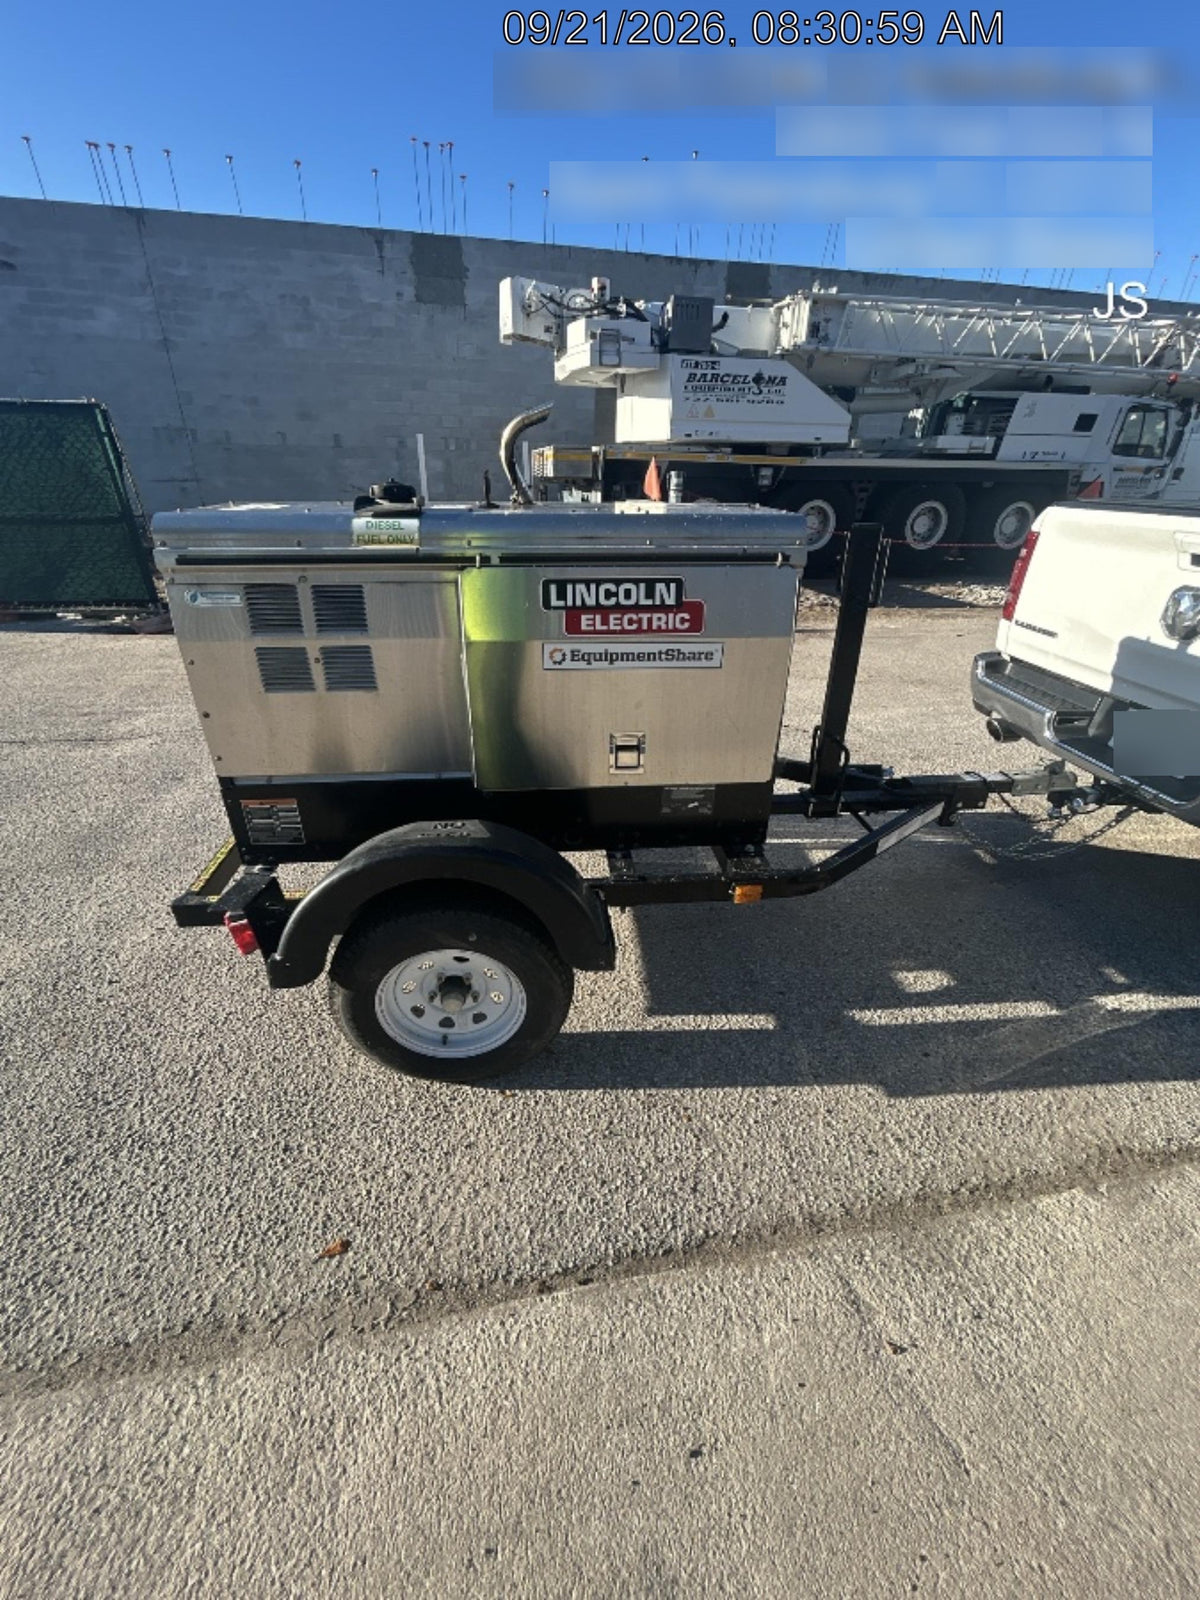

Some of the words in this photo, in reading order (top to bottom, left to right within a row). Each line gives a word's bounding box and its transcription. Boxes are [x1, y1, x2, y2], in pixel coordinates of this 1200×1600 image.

[365, 520, 404, 530] DIESEL
[356, 534, 384, 545] FUEL
[386, 533, 415, 545] ONLY
[549, 582, 677, 607] LINCOLN
[580, 612, 691, 631] ELECTRIC
[569, 648, 714, 666] EquipmentShare
